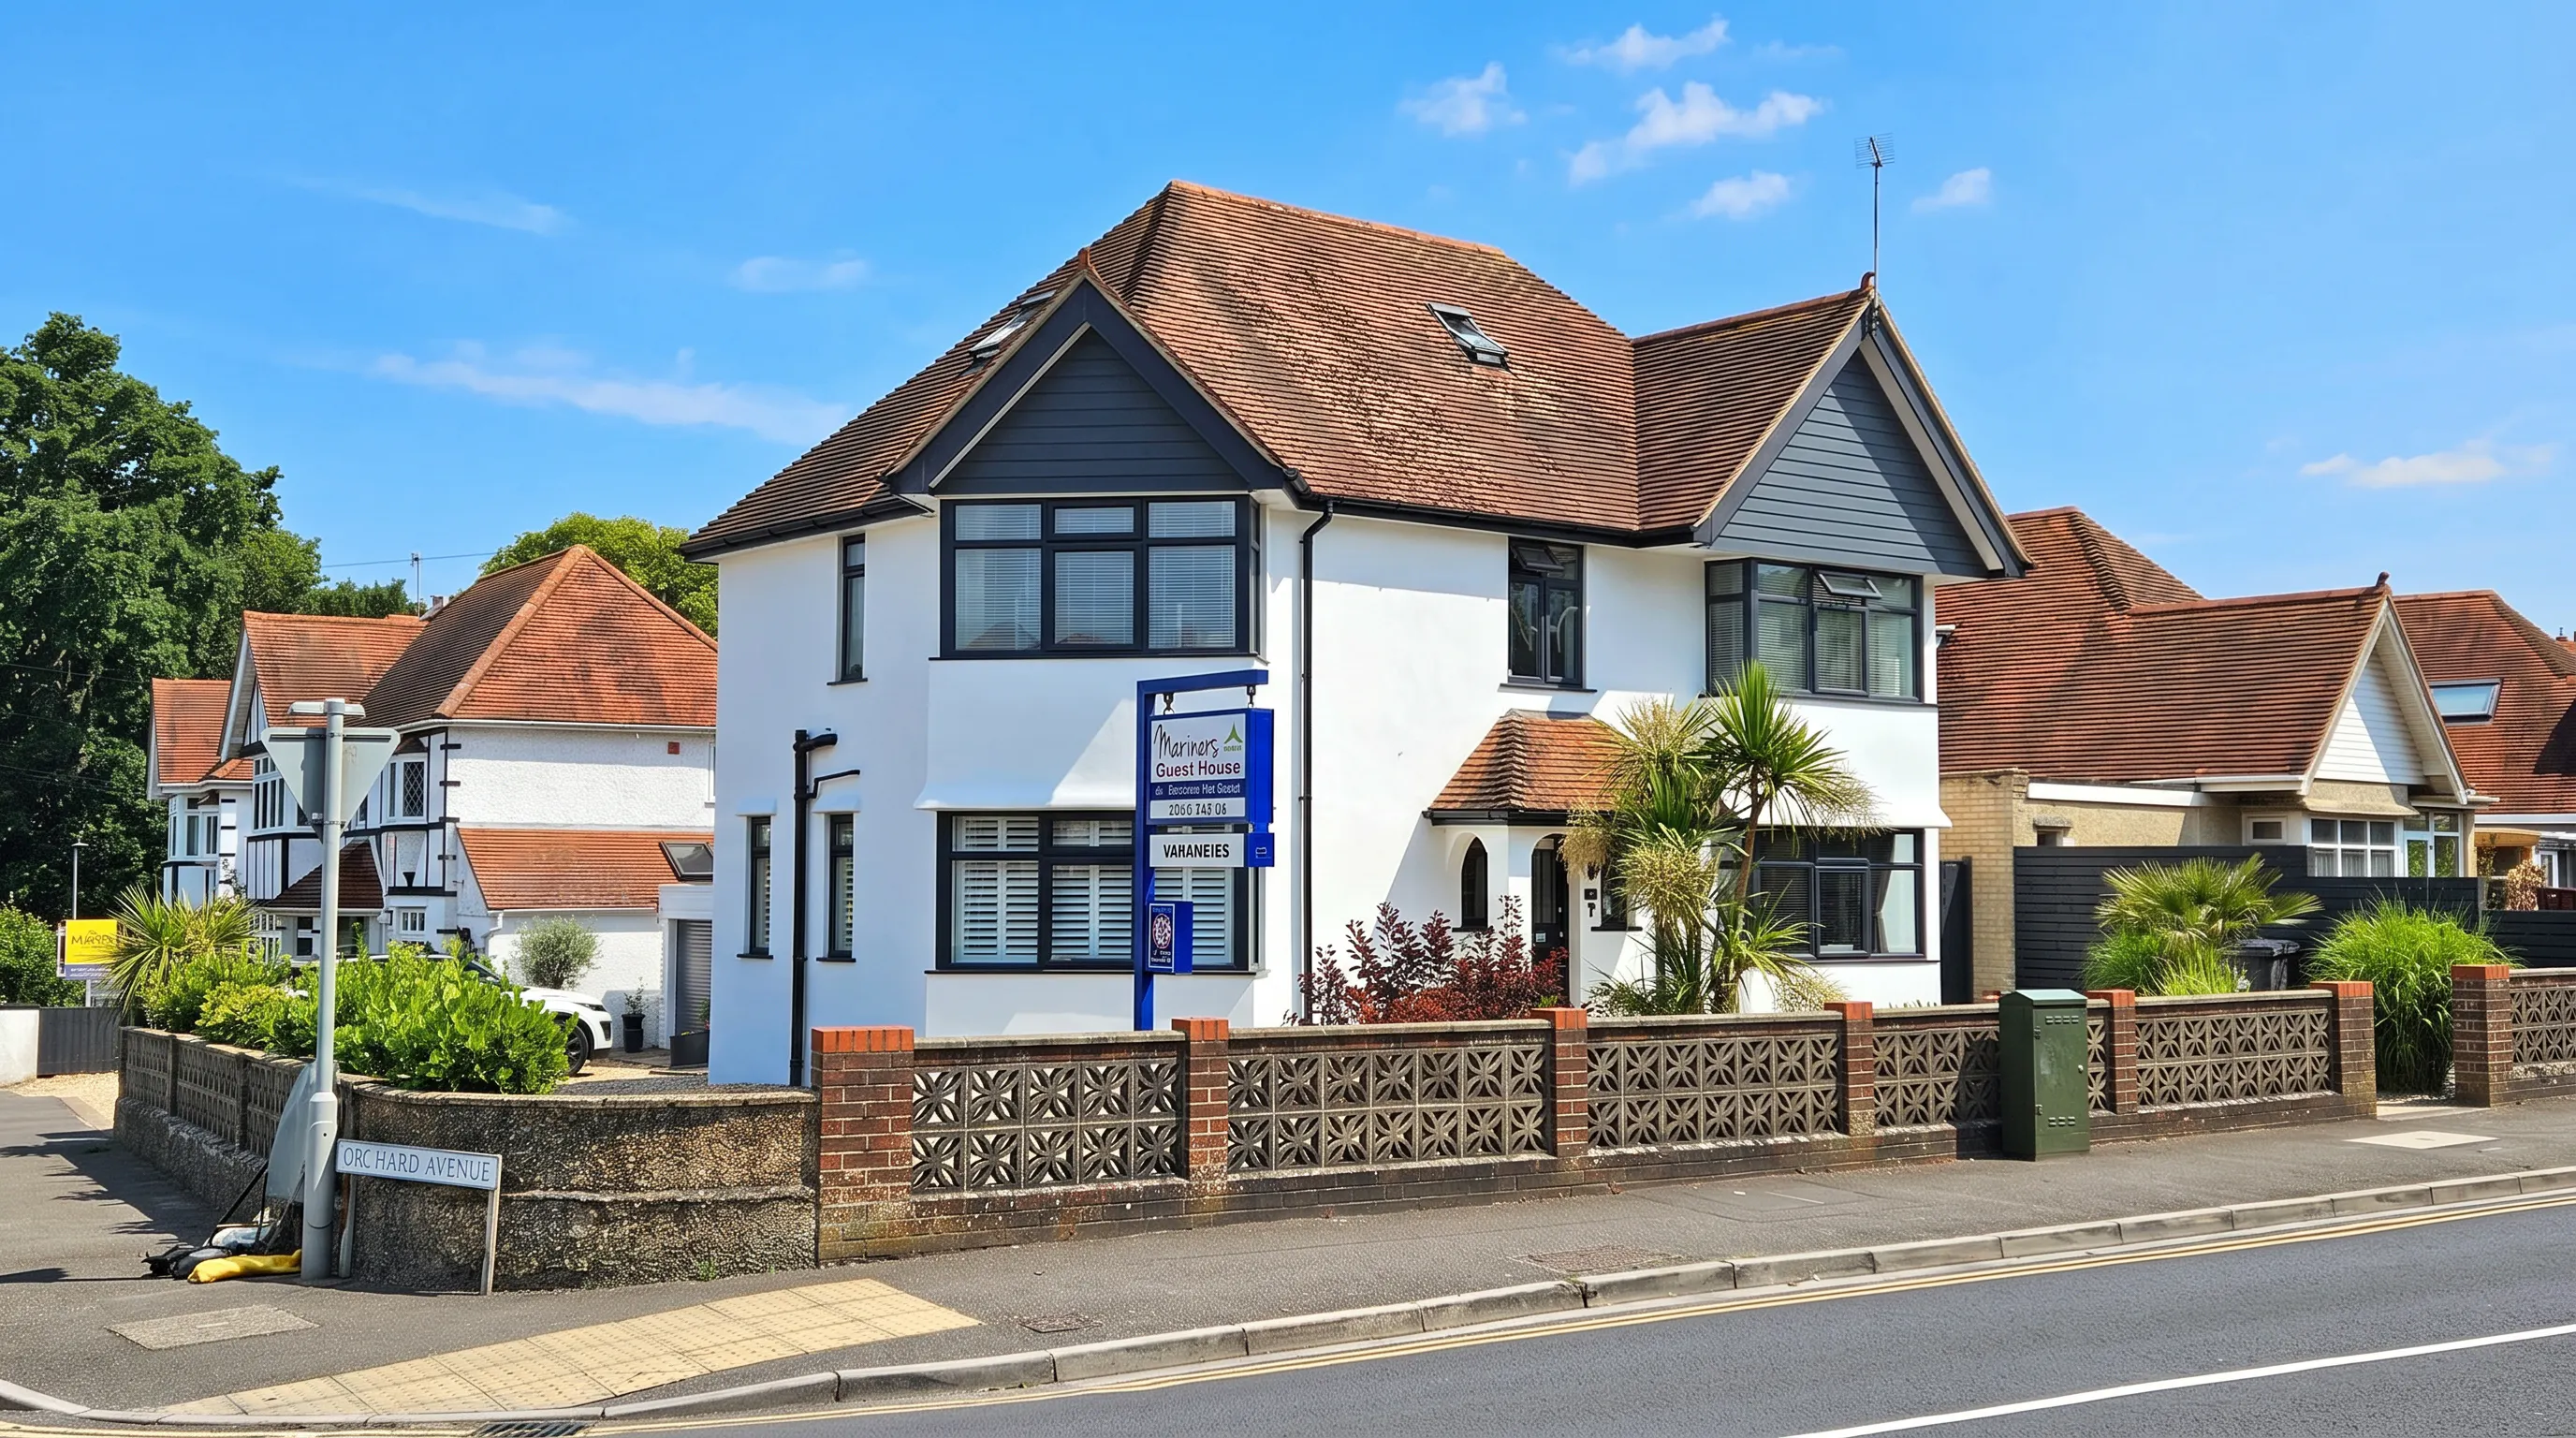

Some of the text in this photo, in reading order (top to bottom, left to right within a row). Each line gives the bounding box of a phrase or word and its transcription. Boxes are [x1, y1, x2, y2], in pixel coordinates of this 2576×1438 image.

[1153, 724, 1220, 759] Mariners
[1156, 759, 1241, 778] Guest House
[1163, 844, 1230, 858] VAHANEIES
[425, 1156, 490, 1181] AVENUE
